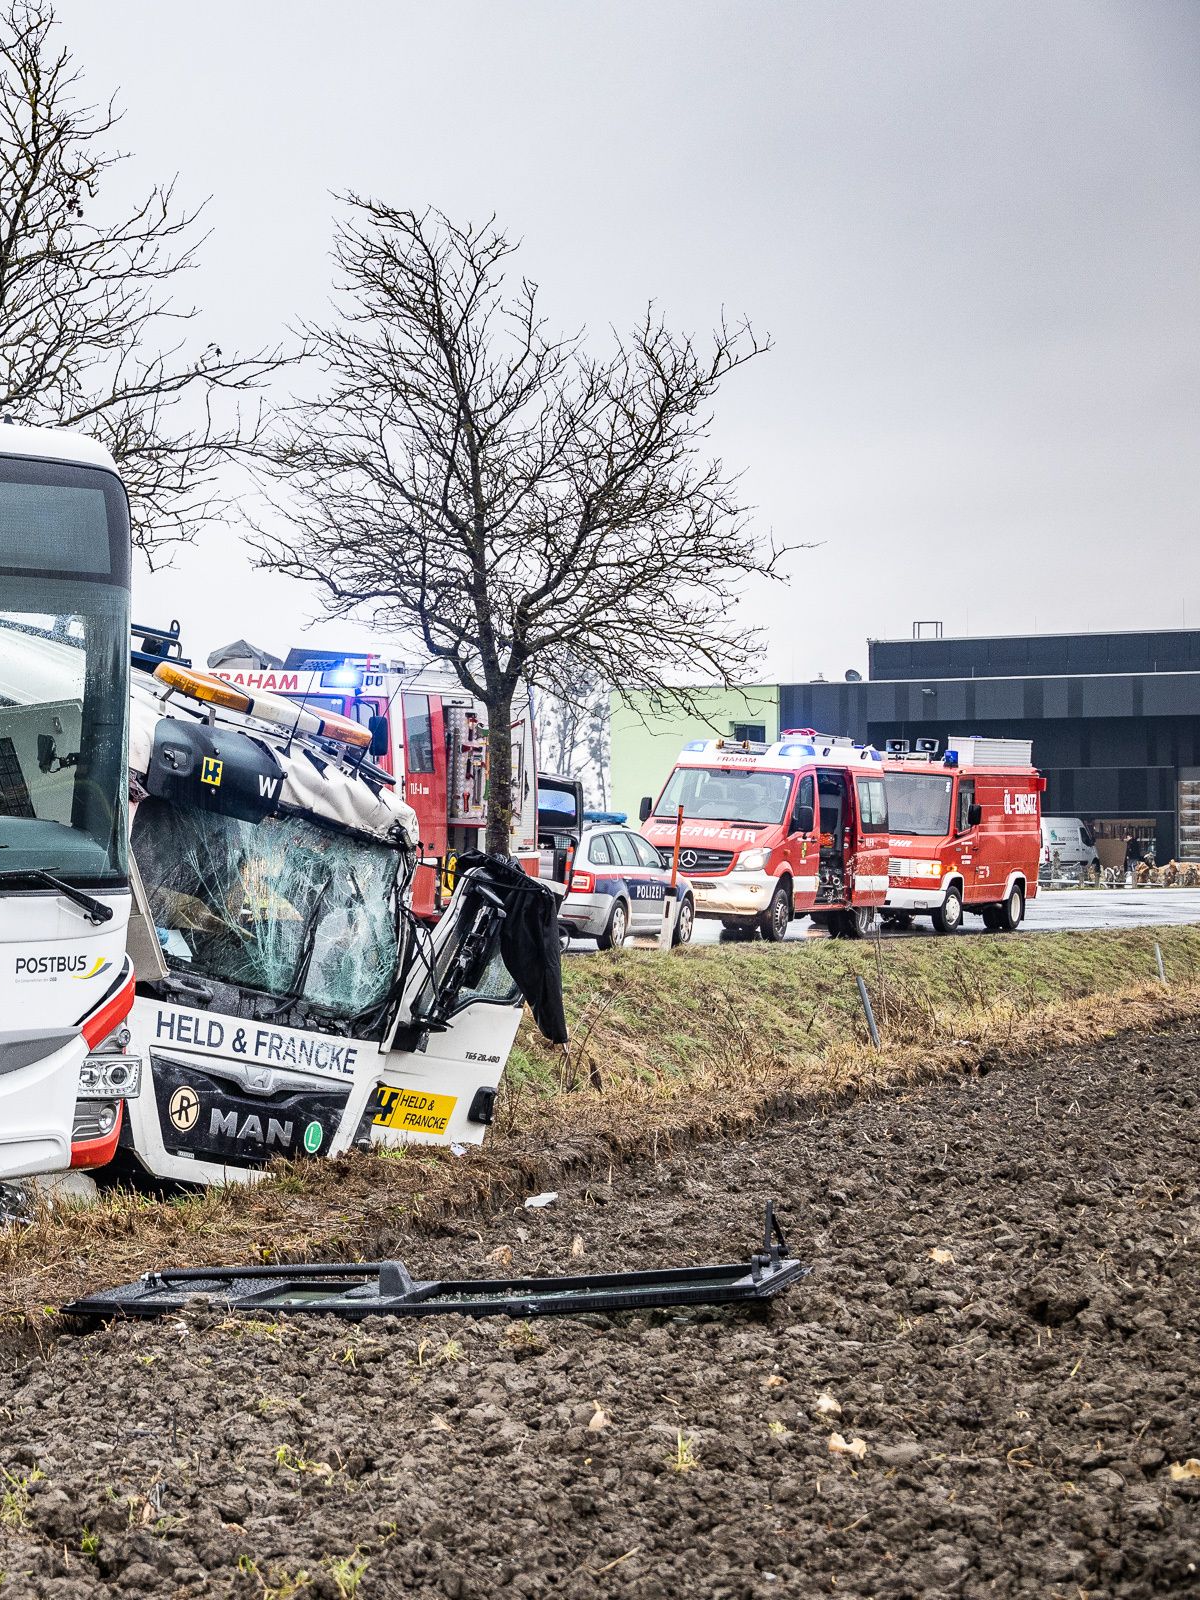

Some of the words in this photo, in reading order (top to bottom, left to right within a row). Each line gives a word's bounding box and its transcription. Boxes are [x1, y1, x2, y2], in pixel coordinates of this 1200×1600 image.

[209, 672, 298, 690] AHAM
[259, 774, 278, 799] W
[636, 885, 662, 898] POLIZEI
[15, 955, 87, 974] POSTBUS
[156, 1010, 225, 1048] HELD
[232, 1028, 248, 1054] &
[254, 1030, 358, 1075] FRANCKE
[400, 1094, 427, 1110] HELD
[427, 1100, 435, 1111] &
[209, 1107, 294, 1147] MAN
[402, 1113, 447, 1130] FRANCKE
[308, 1126, 317, 1148] L
